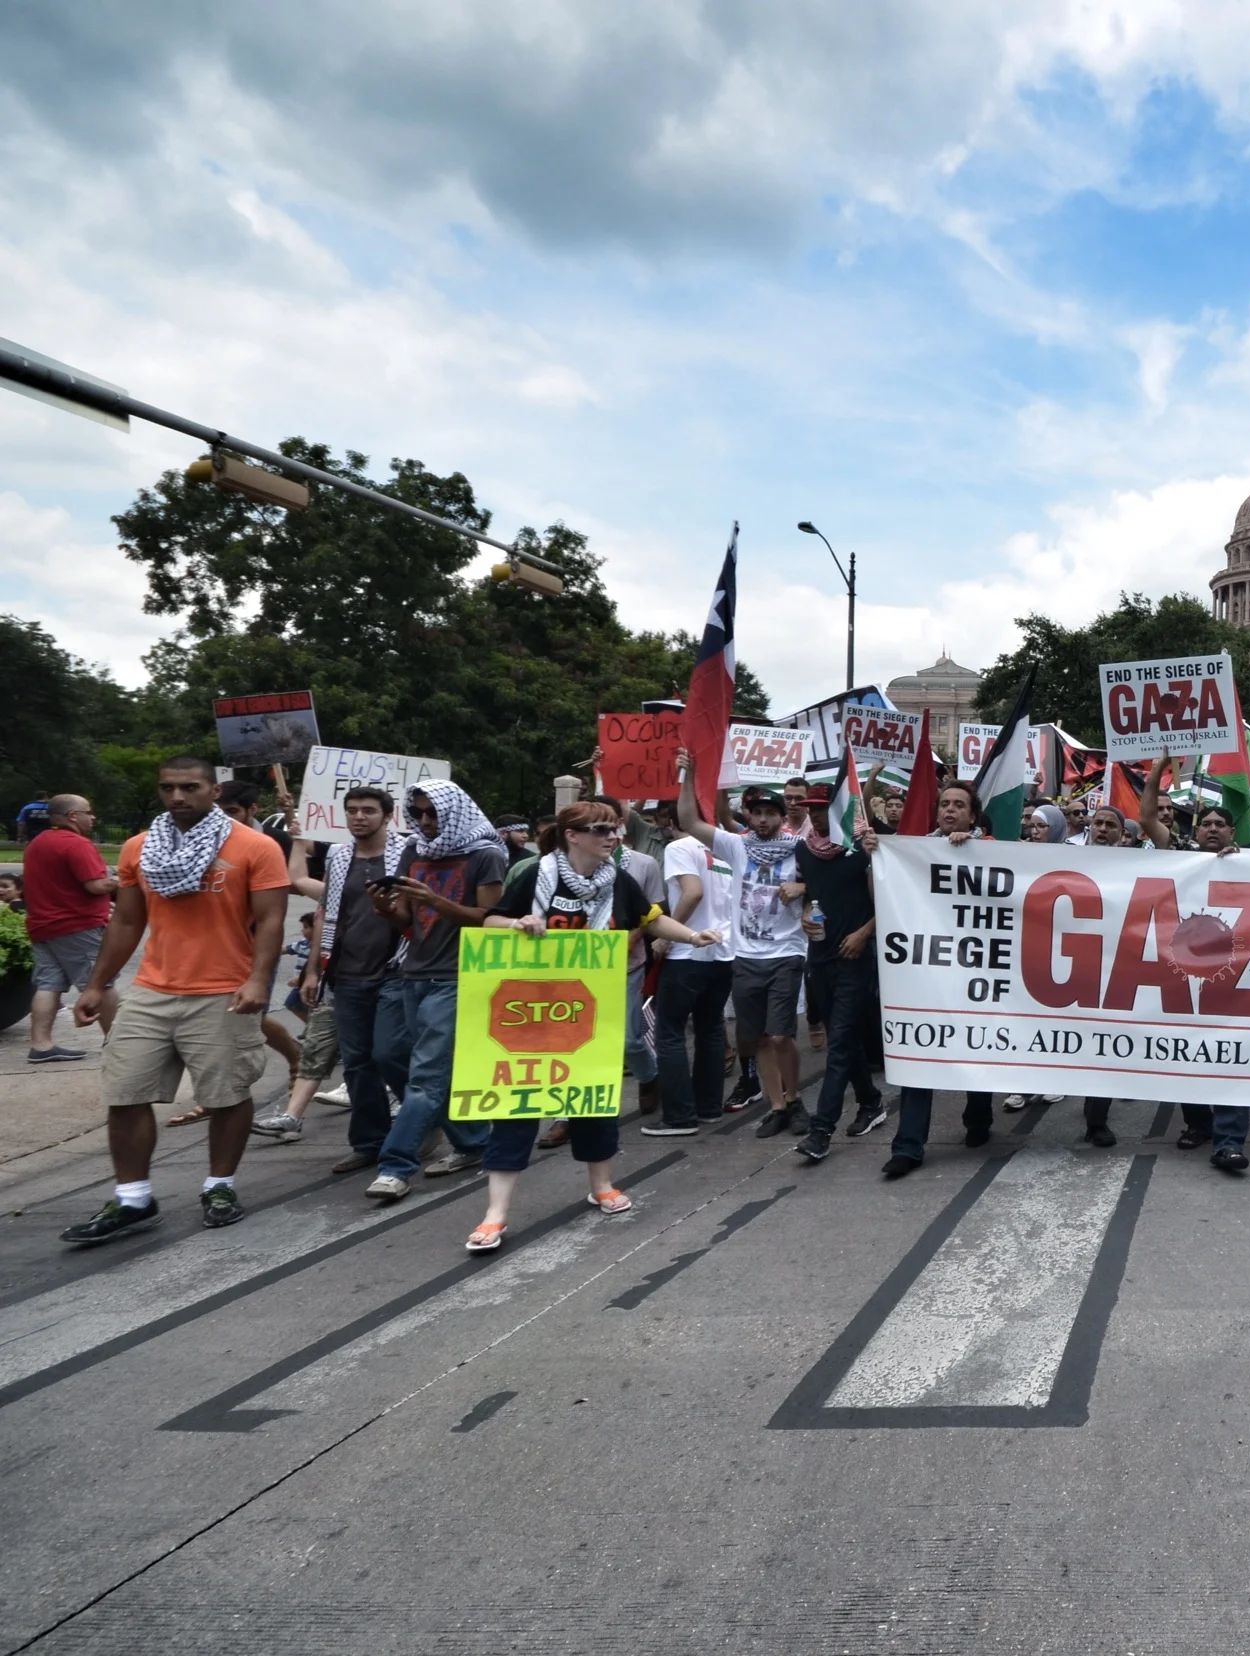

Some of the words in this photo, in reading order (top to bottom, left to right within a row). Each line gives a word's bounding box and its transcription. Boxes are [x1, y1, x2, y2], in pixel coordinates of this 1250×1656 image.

[1106, 669, 1131, 683] END
[1136, 667, 1160, 680] THE
[1165, 663, 1202, 679] SIEGE
[1207, 661, 1223, 675] OF
[847, 707, 863, 716] END
[866, 709, 881, 719] THE
[883, 712, 906, 722] SIEGE
[908, 716, 920, 725] OF
[1108, 678, 1228, 735] GAZA
[733, 728, 751, 736] END
[753, 729, 770, 738] THE
[772, 731, 797, 740] SIEGE
[799, 733, 811, 741] OF
[845, 716, 915, 754] GAZA
[963, 726, 980, 735] END
[982, 728, 999, 736] THE
[1027, 731, 1037, 739] OF
[1112, 737, 1136, 746] STOP
[1139, 735, 1156, 744] U.S.
[1158, 733, 1177, 743] AID
[1178, 732, 1192, 741] TO
[1195, 730, 1229, 740] ISRAEL
[645, 746, 663, 762] IS
[730, 736, 803, 769] GAZA
[312, 747, 388, 782] JEWS
[396, 759, 408, 788] 4
[417, 762, 433, 782] A
[930, 863, 1015, 898] END
[555, 898, 583, 909] SOLID
[952, 904, 1015, 931] THE
[461, 932, 622, 973] MILITARY
[884, 931, 1013, 970] SIEGE
[967, 977, 1011, 1003] OF
[500, 1000, 585, 1026] STOP
[884, 1020, 956, 1048] STOP
[965, 1025, 1017, 1052] U.S.
[1027, 1029, 1083, 1055] AID
[1092, 1032, 1134, 1059] TO
[1144, 1036, 1250, 1066] ISRAEL
[491, 1058, 570, 1086] AID
[453, 1089, 500, 1117] TO
[509, 1084, 617, 1116] ISRAEL
